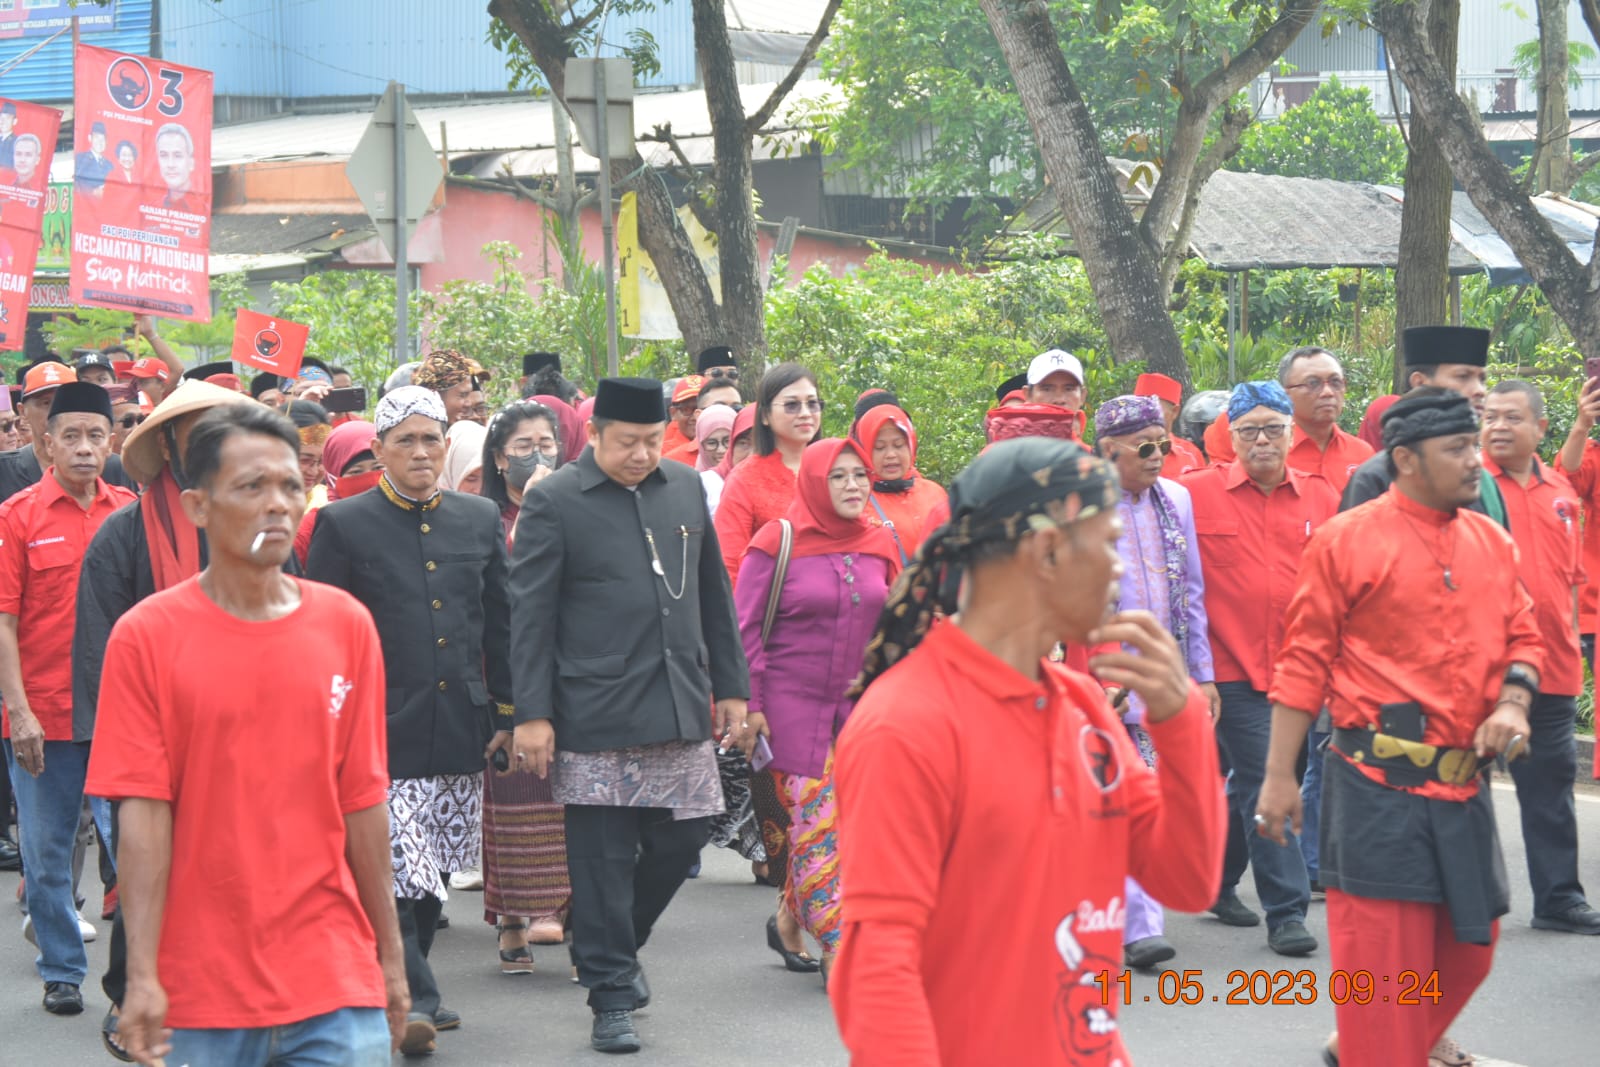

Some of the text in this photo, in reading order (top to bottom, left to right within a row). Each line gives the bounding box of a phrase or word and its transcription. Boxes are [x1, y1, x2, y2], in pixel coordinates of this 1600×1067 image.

[157, 68, 184, 117] 3
[75, 232, 205, 272] KECAMATAN PANONGAN
[102, 225, 179, 246] PAC PDI PERJUANGAN
[85, 257, 193, 295] Siap Hattrick
[268, 321, 277, 330] 3
